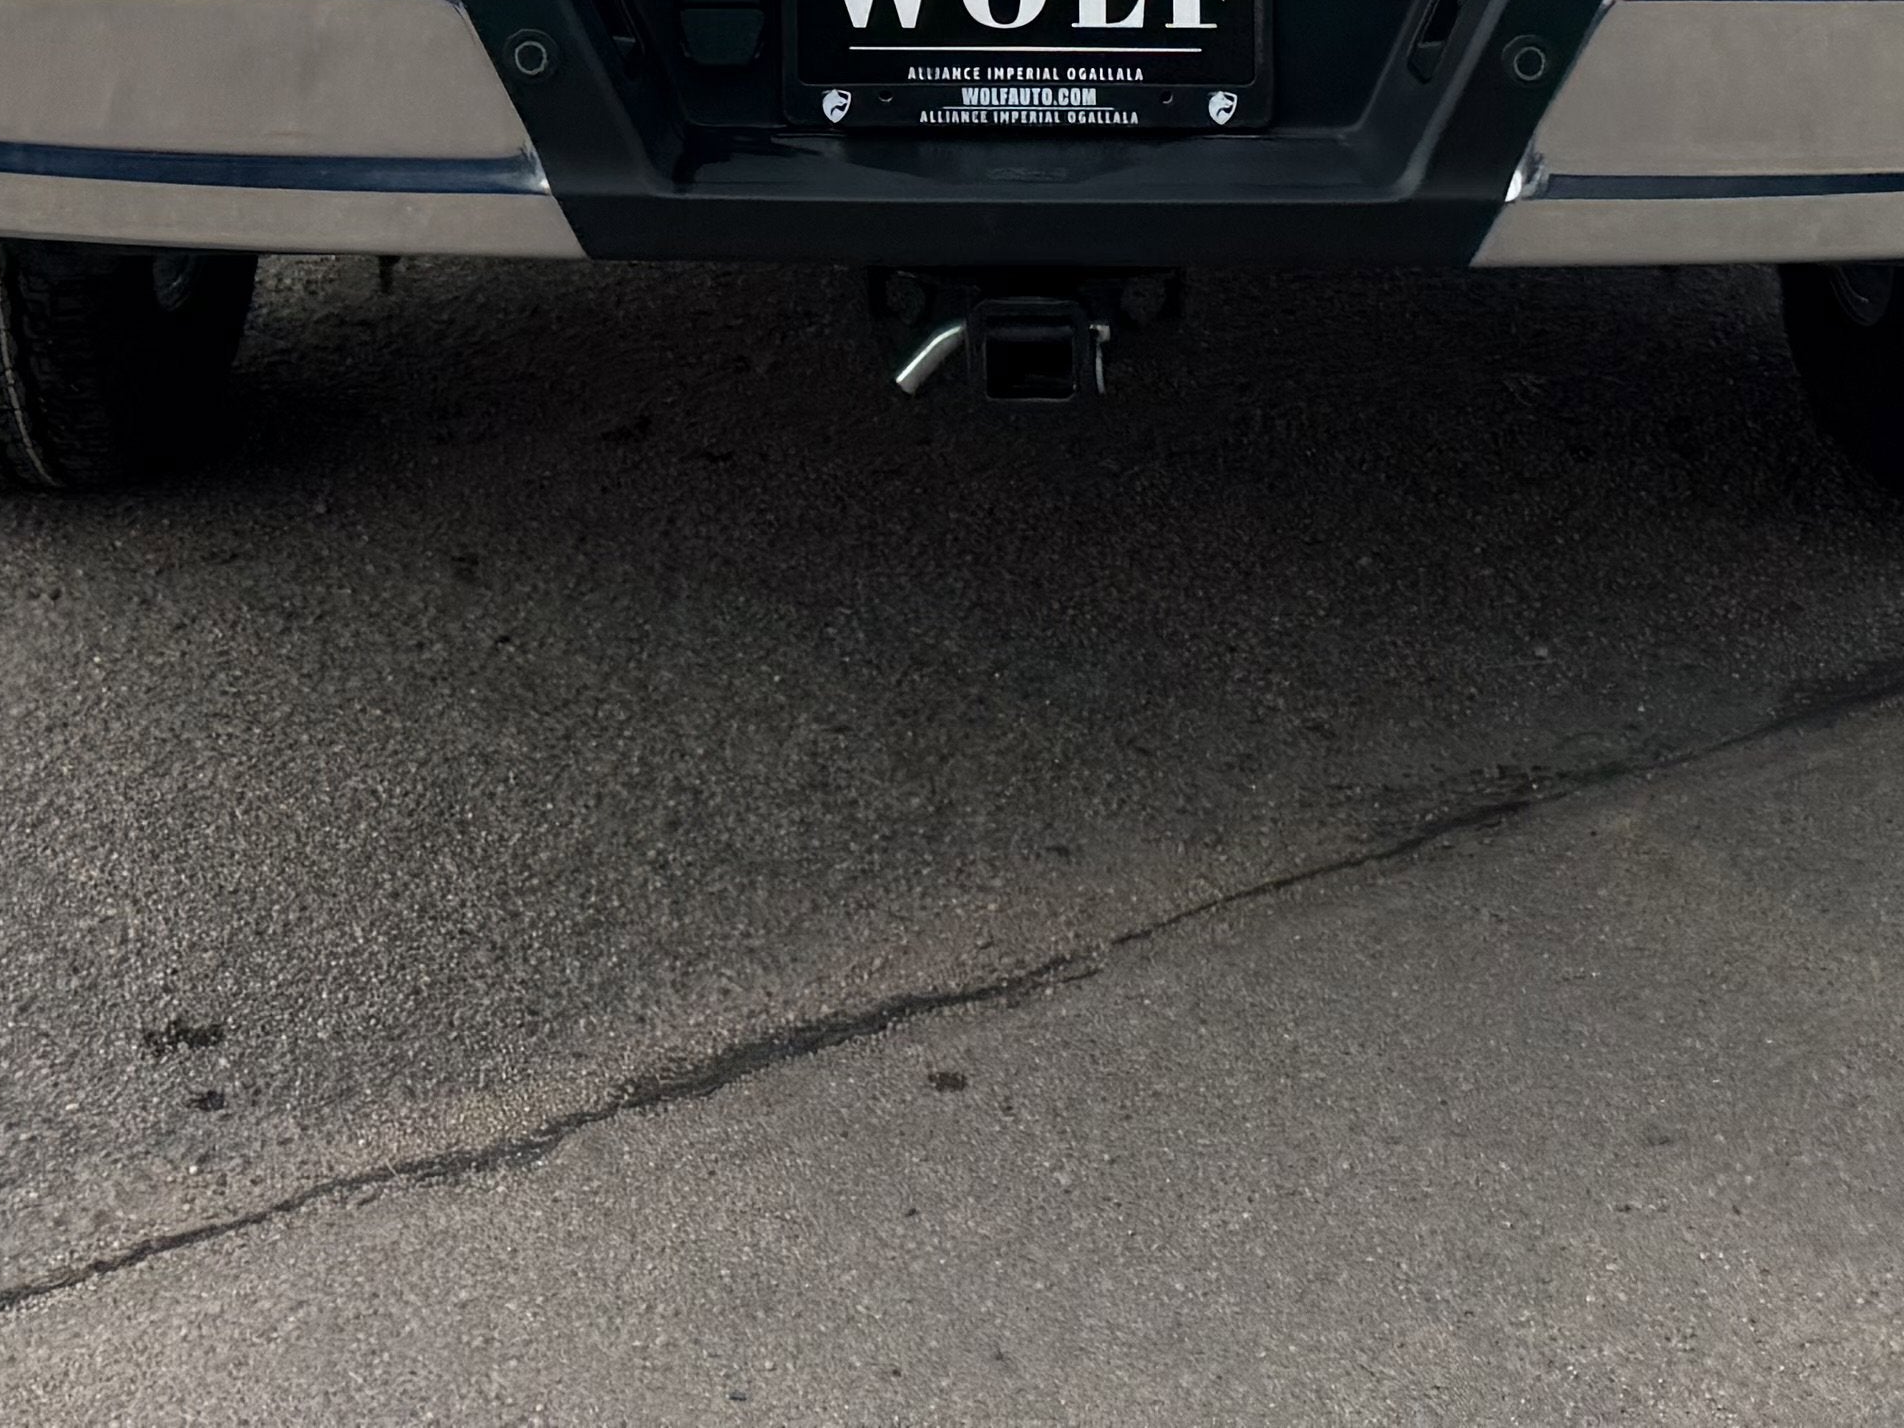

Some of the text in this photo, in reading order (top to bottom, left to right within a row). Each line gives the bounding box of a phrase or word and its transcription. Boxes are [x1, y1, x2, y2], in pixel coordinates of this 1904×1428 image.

[908, 66, 1144, 81] ALLIANCE IMPERIAL OGALLALA
[961, 87, 1097, 106] WOLFAUTO.COM
[920, 110, 1139, 124] ALLIANCE IMPERIAL OGALLALA
